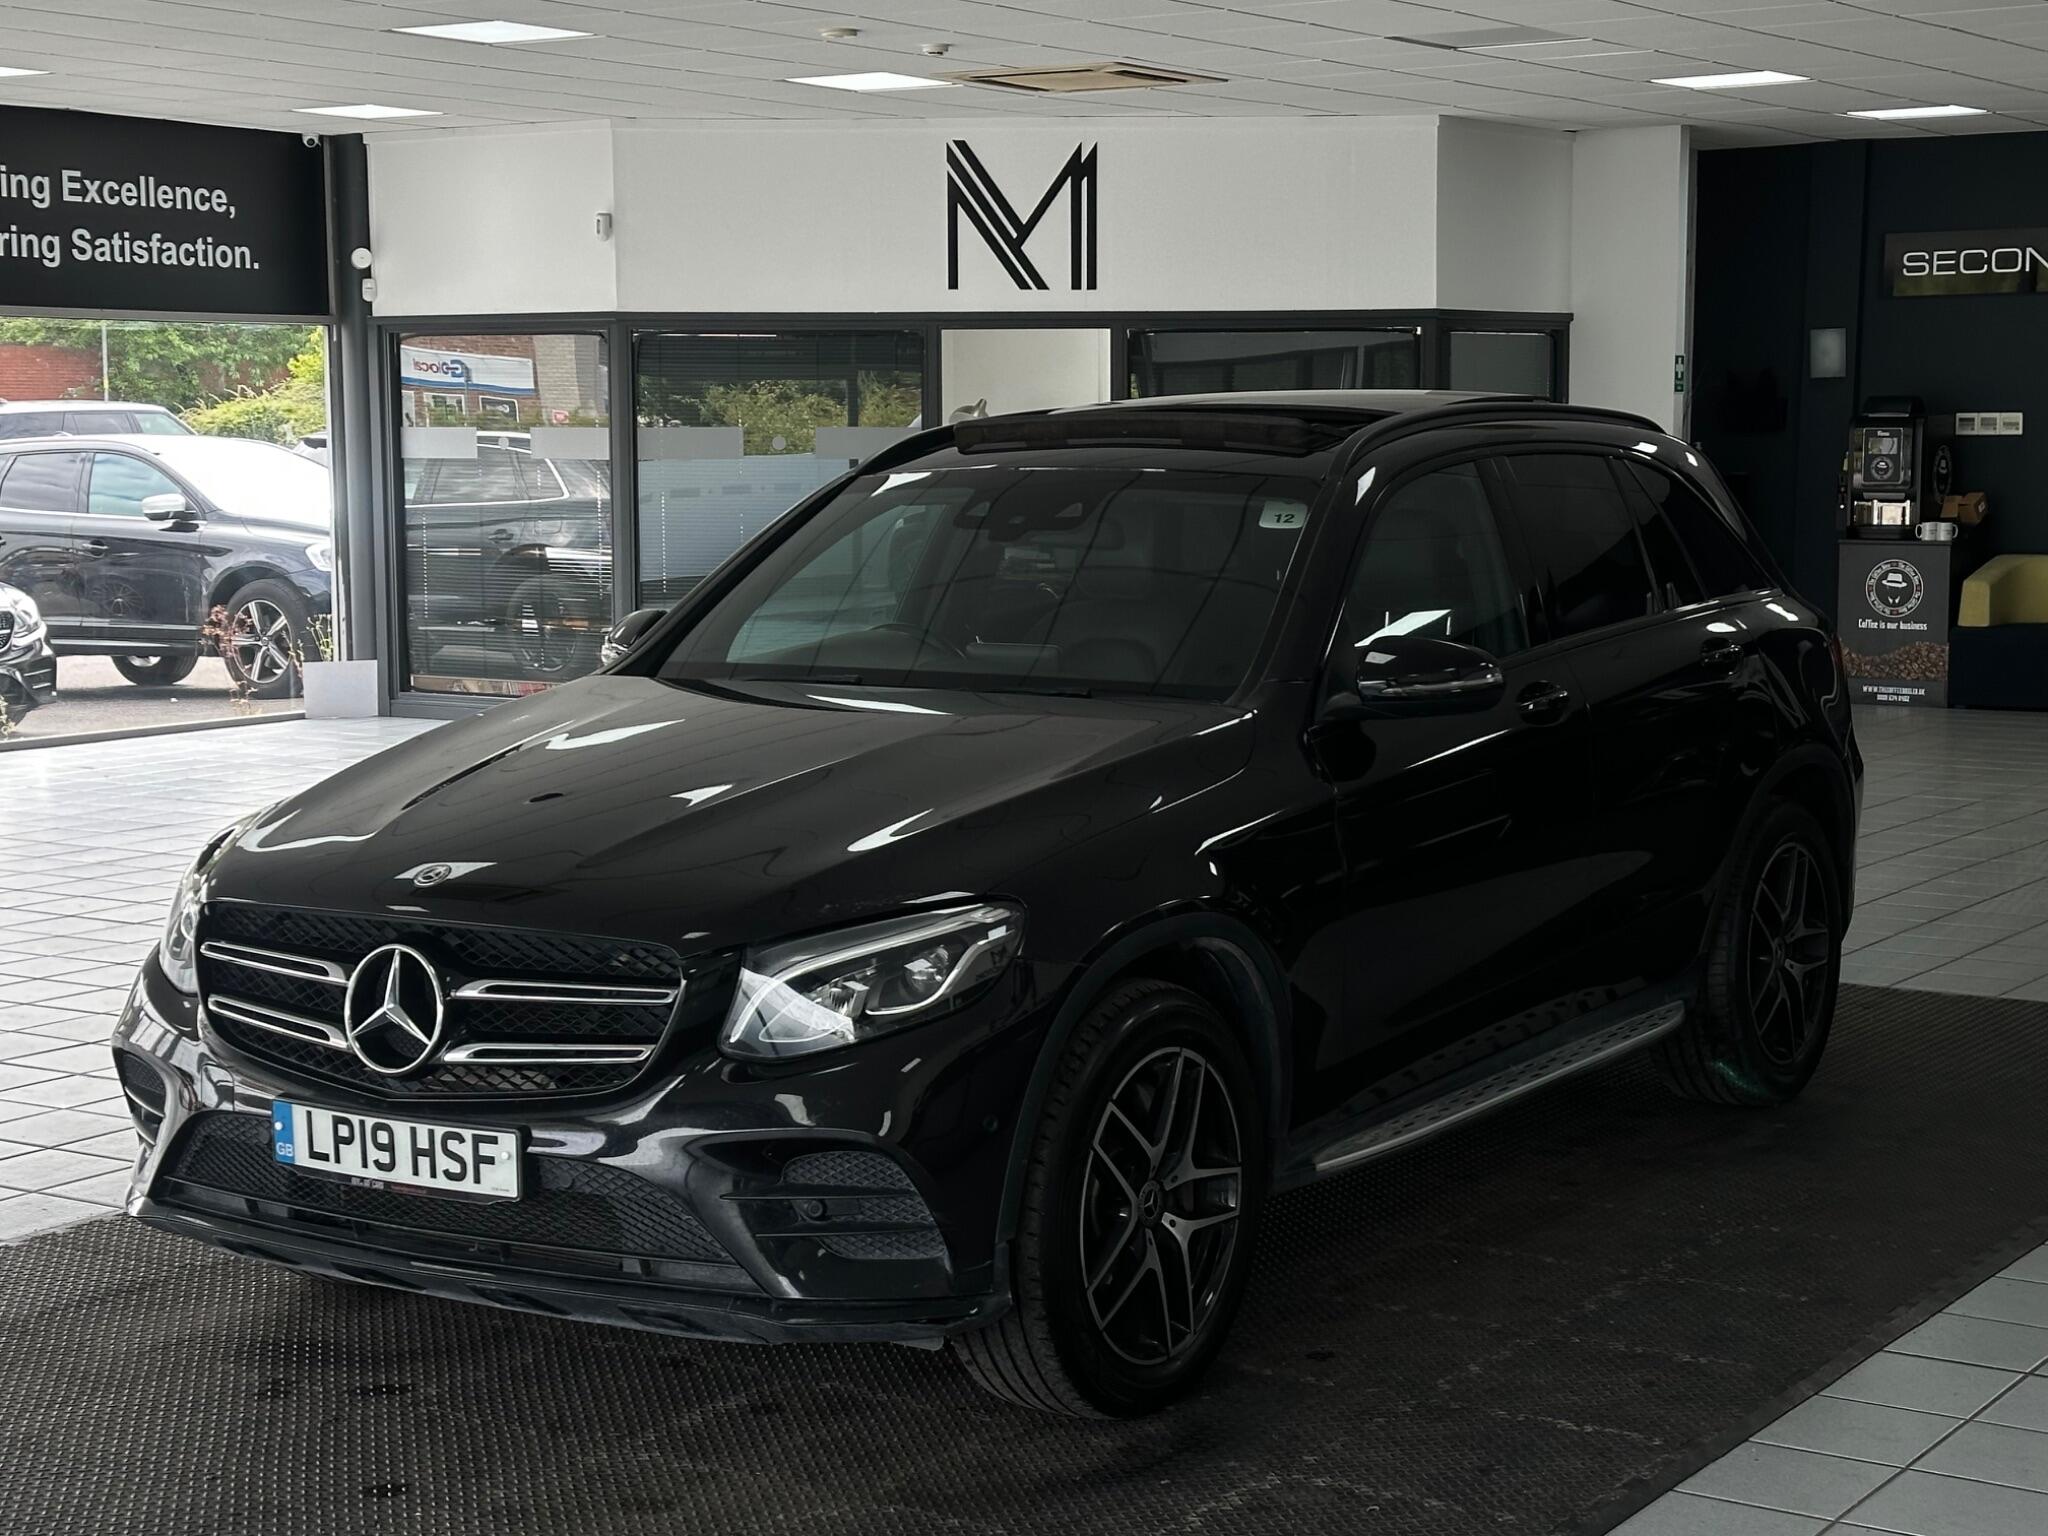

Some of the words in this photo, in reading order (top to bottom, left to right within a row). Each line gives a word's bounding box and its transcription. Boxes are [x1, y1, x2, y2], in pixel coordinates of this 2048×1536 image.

[0, 165, 50, 209] ing
[61, 169, 236, 219] Excellence,
[71, 227, 260, 270] Satisfaction.
[1274, 513, 1295, 524] 12
[276, 1142, 294, 1157] GB
[305, 1110, 396, 1173] LP19
[409, 1126, 499, 1184] HSF
